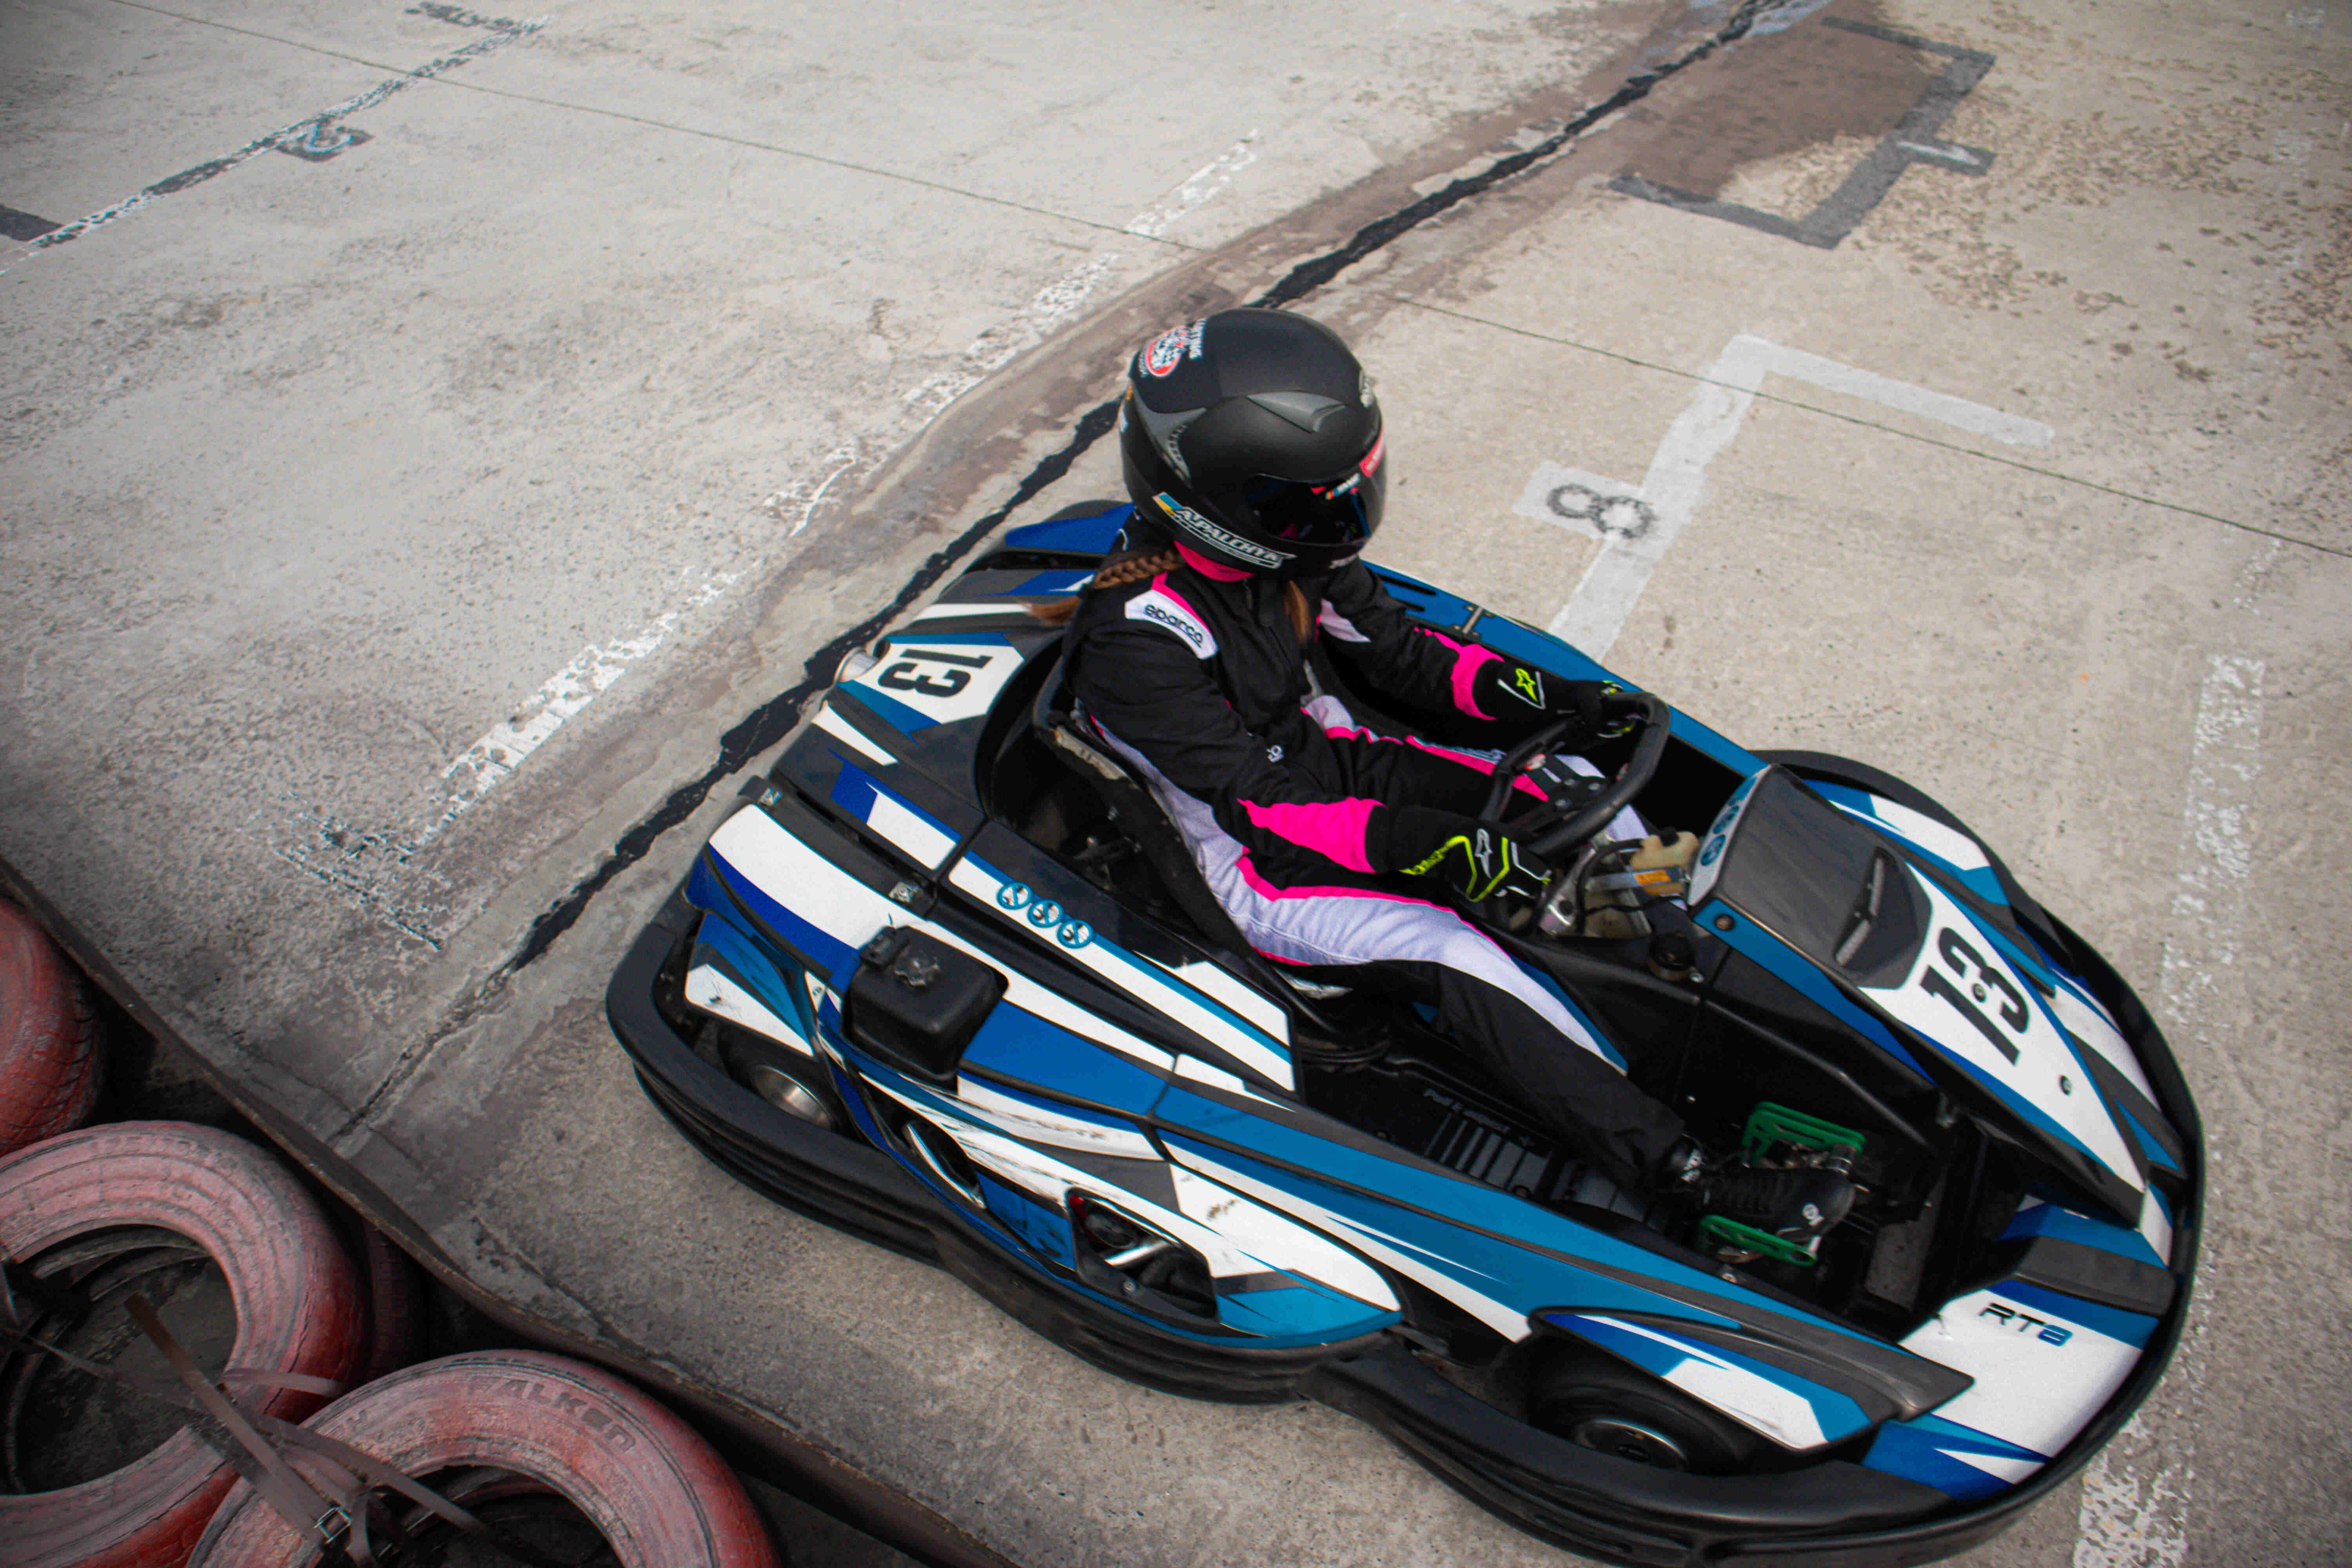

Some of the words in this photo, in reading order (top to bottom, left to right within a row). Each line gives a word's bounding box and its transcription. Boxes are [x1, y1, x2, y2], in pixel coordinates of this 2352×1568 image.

[1546, 483, 1655, 538] 8
[1143, 604, 1205, 647] sparco
[878, 649, 993, 697] 13
[1920, 927, 2029, 1067] 13
